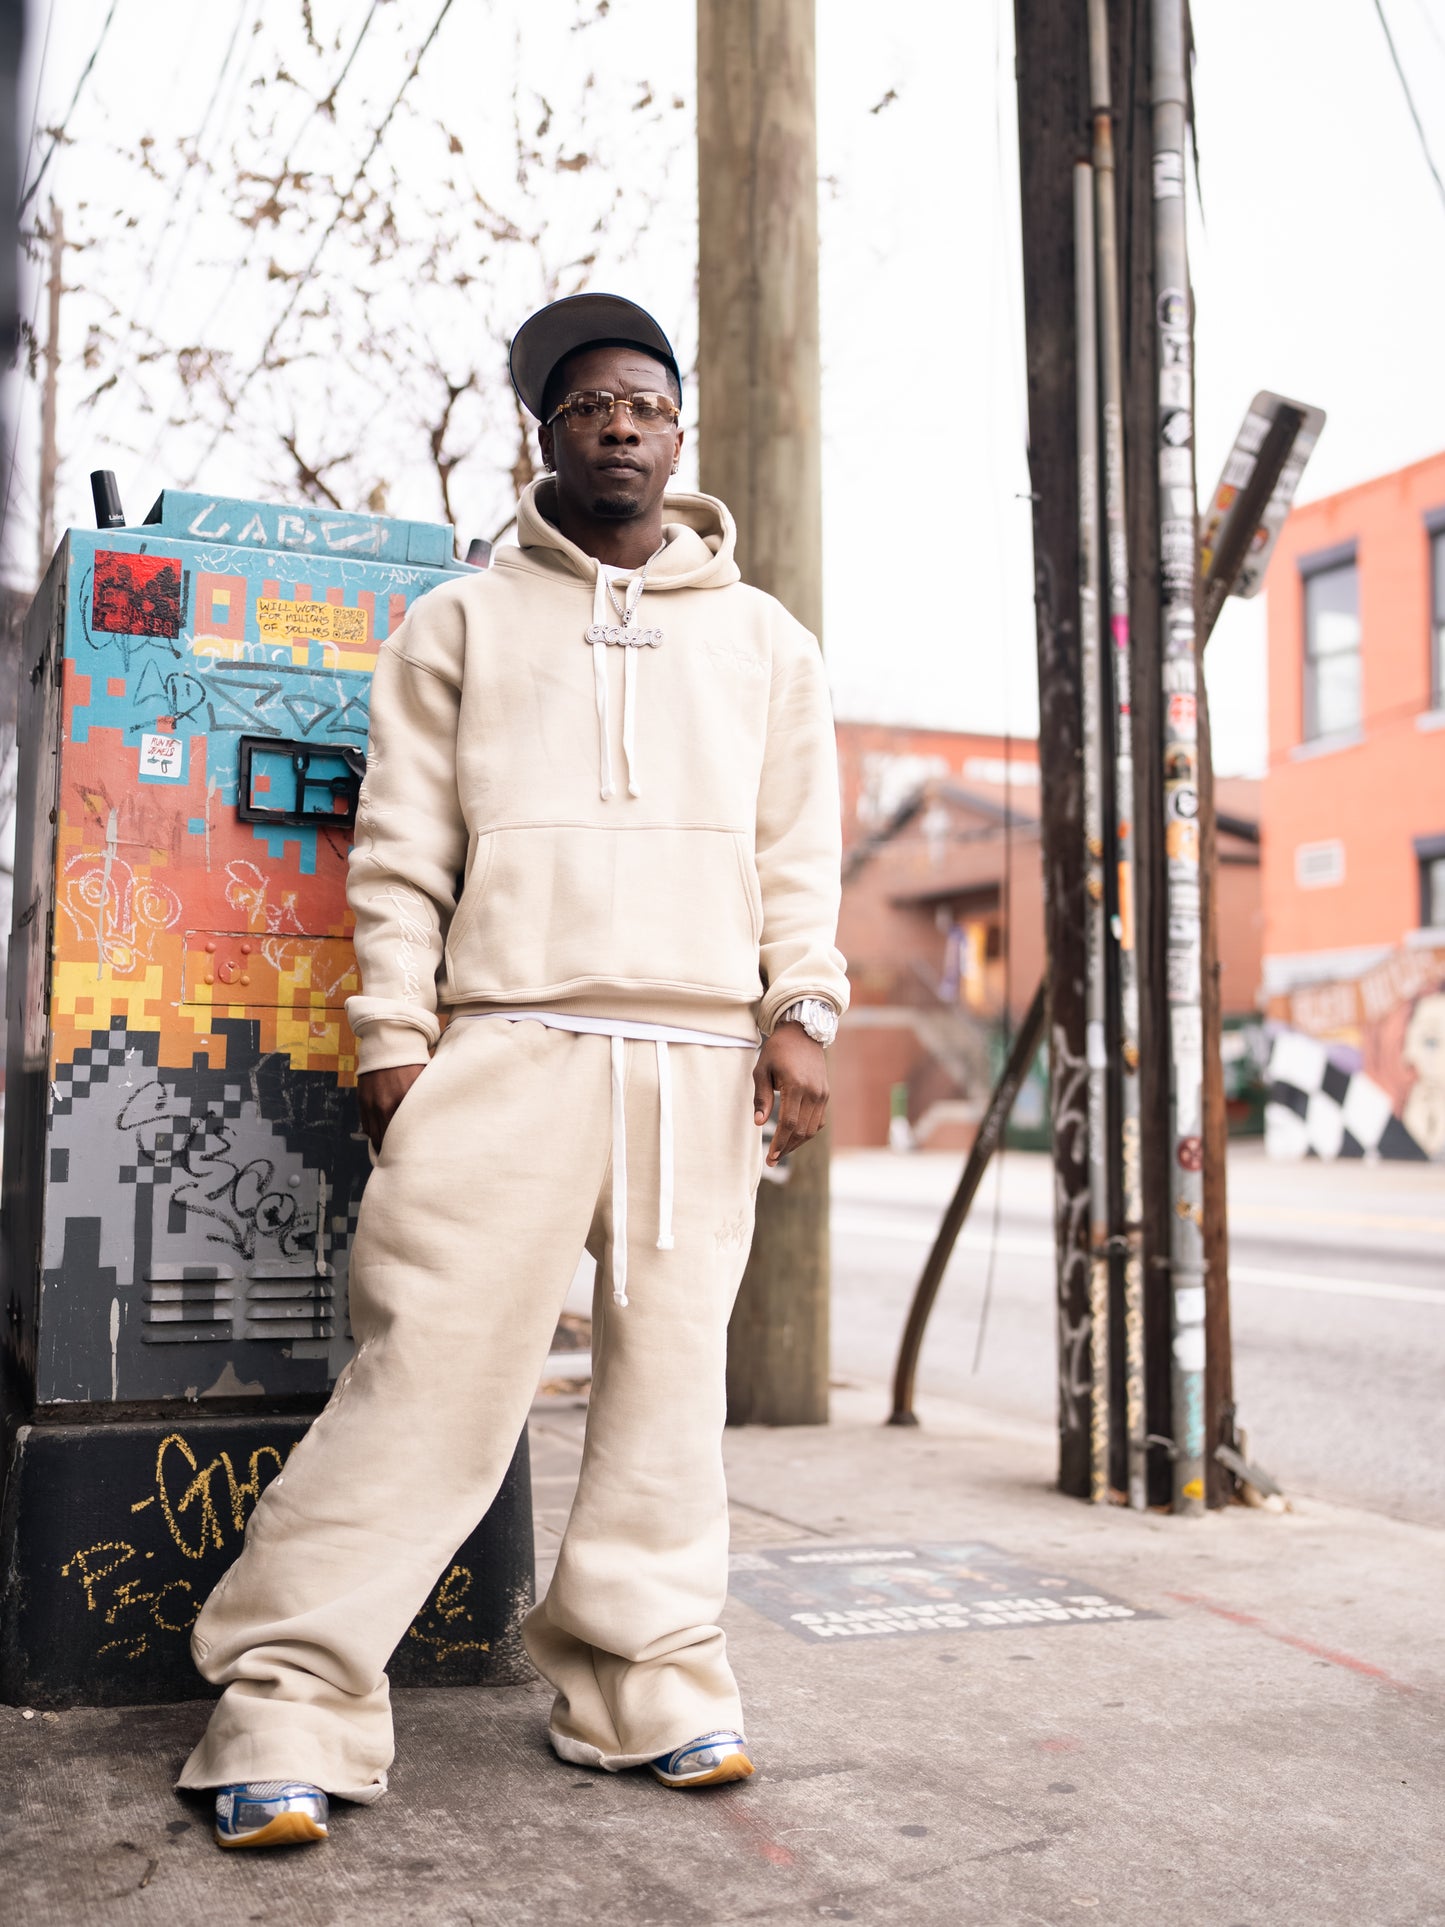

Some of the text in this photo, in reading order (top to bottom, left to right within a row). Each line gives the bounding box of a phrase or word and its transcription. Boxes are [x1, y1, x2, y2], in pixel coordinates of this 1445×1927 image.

[260, 601, 327, 614] WILL WORK
[260, 612, 329, 626] FOR MILLIONS
[263, 623, 329, 638] OF DOLLARS
[972, 1597, 1062, 1612] THE
[790, 1603, 969, 1625] SAINTS
[807, 1605, 1136, 1637] SHANE SMITH
